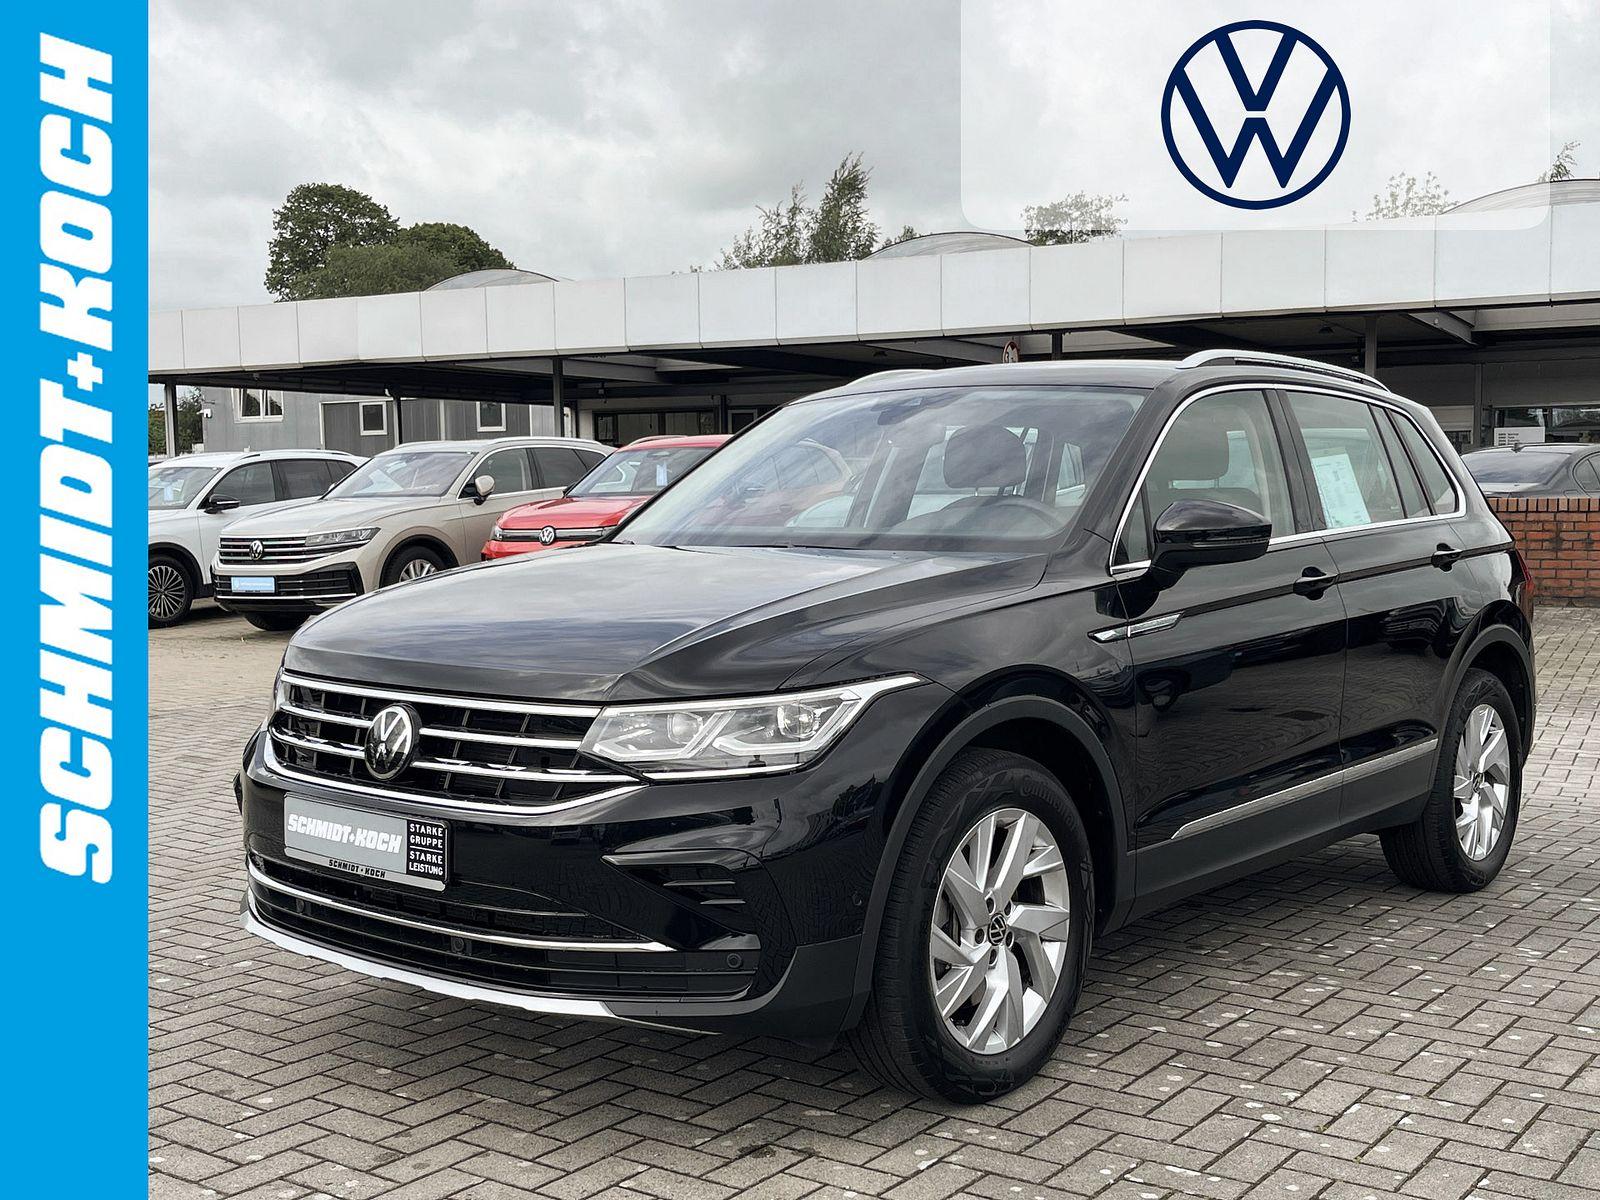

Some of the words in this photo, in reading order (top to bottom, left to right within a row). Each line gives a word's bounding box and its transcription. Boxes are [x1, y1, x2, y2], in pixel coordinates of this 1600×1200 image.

[409, 823, 443, 837] STARKE
[410, 835, 443, 849] GRUPPE
[409, 851, 443, 865] STARKE
[408, 864, 444, 876] LEISTUNG
